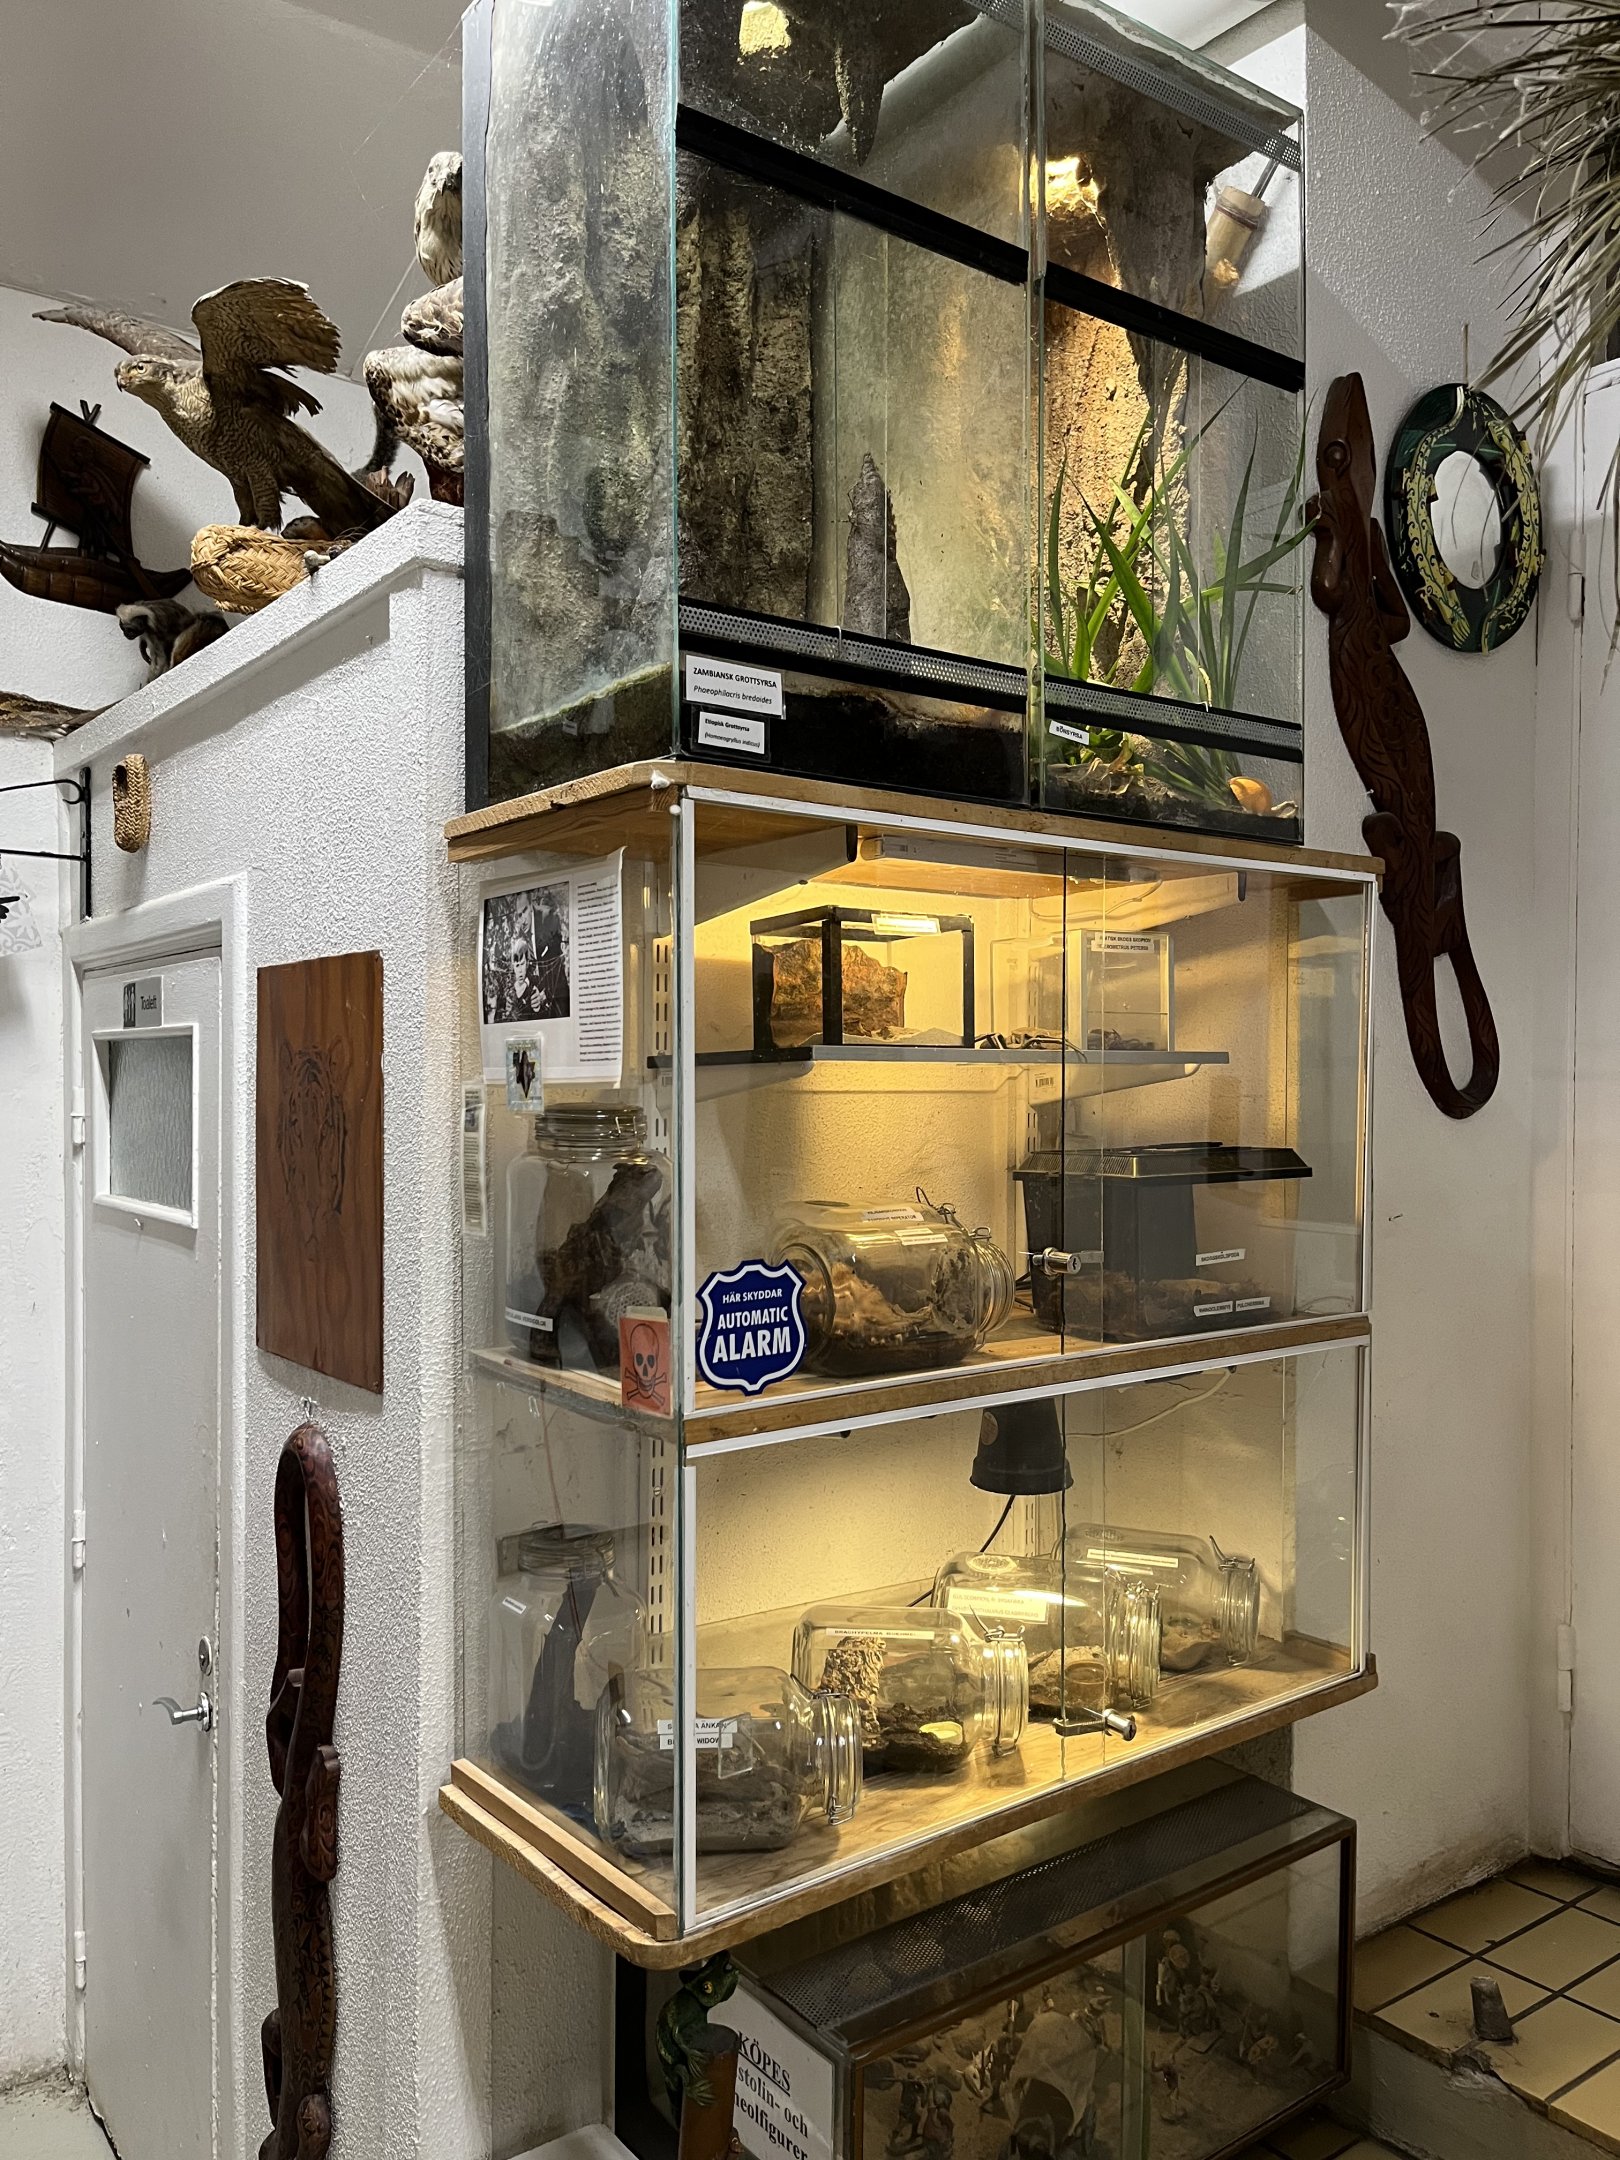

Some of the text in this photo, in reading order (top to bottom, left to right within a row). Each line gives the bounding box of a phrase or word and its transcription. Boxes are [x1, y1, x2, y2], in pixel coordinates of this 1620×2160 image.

[693, 667, 777, 688] ZAMBIANSK GROTTSYRSA
[693, 685, 772, 704] Phaeophilacris bredoides
[725, 722, 750, 732] Grottsyrsa
[722, 1288, 783, 1304] HÄR SKYDDAR
[717, 1306, 789, 1330] AUTOMATIC
[712, 1326, 792, 1364] ALARM
[738, 2031, 791, 2092] KÖPES
[738, 2066, 808, 2138] stolin- och
